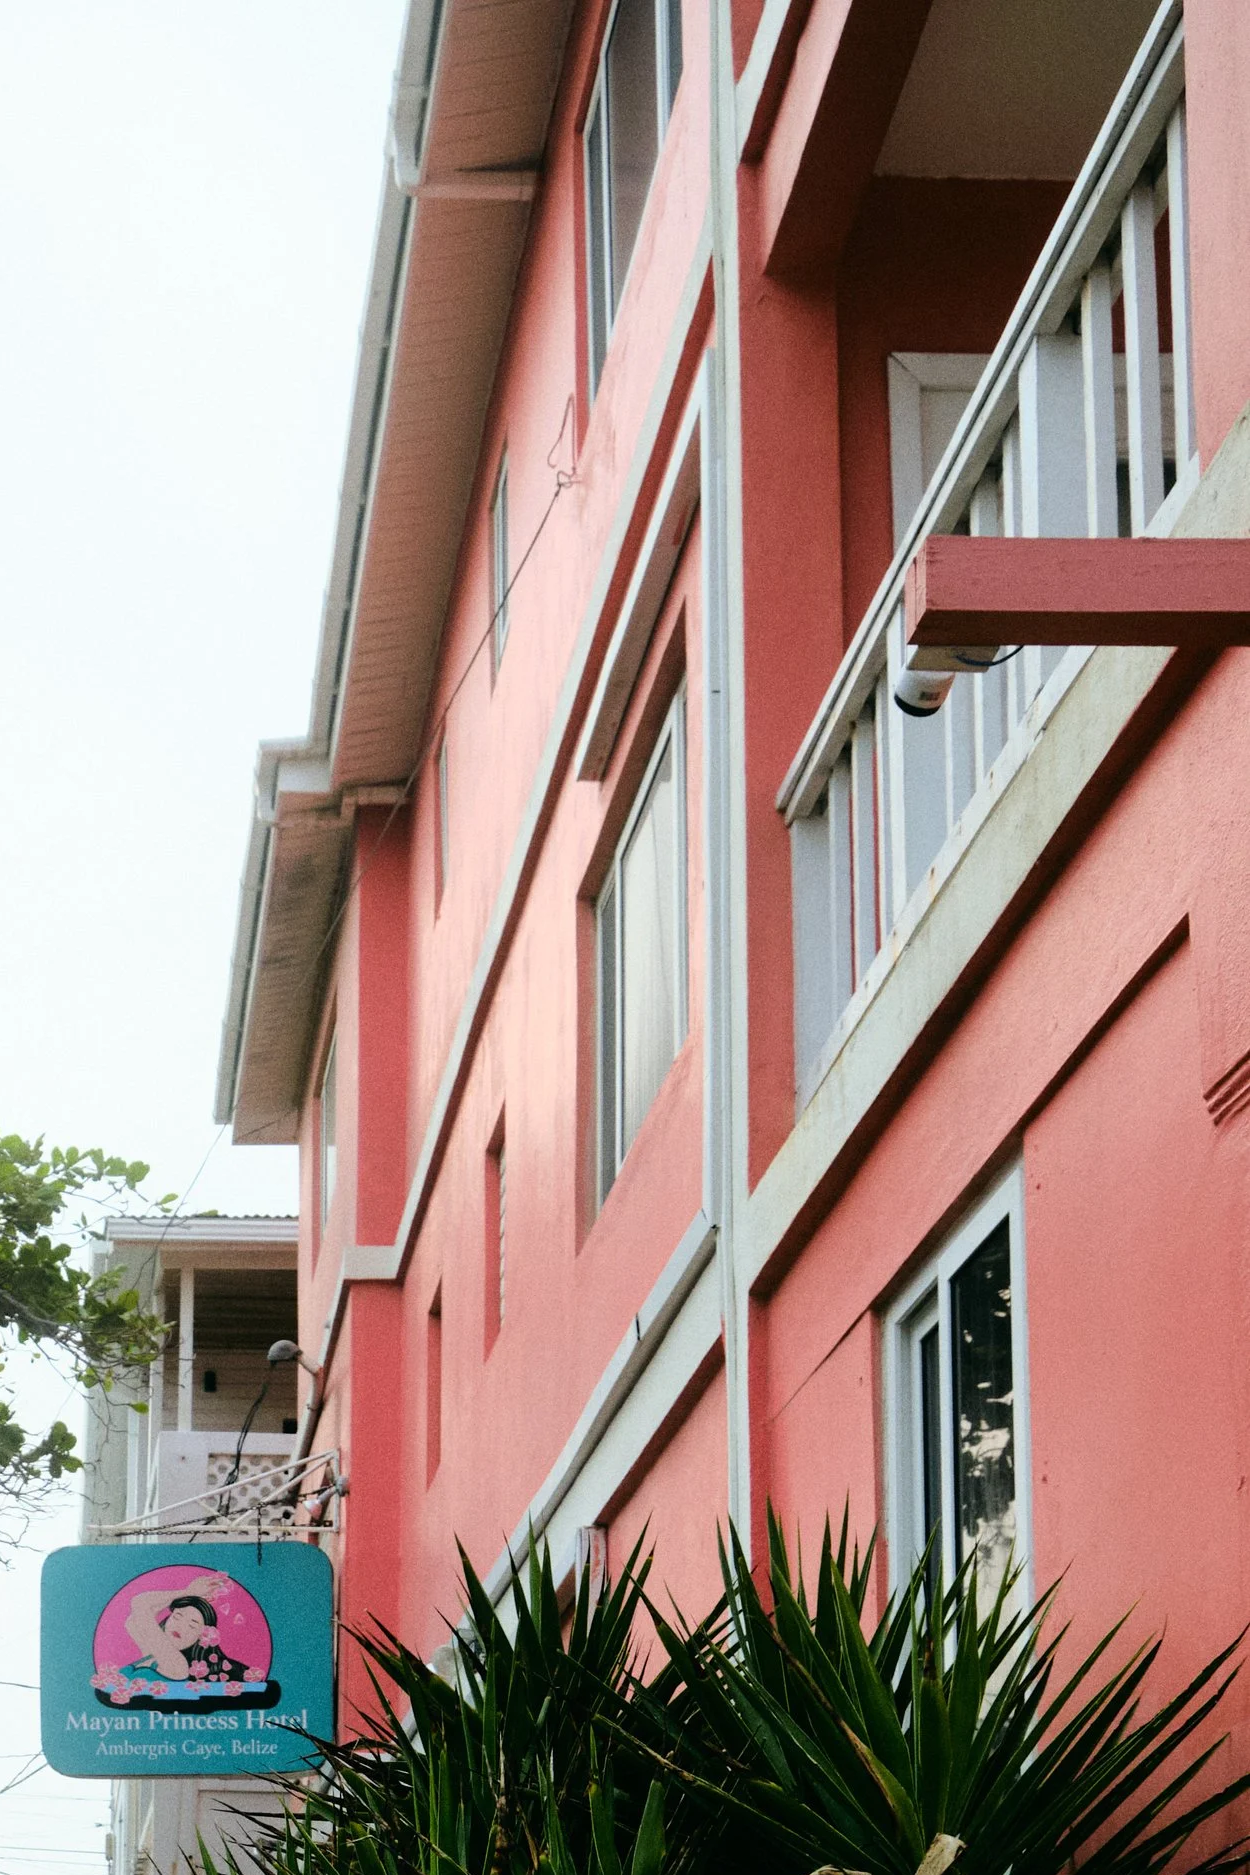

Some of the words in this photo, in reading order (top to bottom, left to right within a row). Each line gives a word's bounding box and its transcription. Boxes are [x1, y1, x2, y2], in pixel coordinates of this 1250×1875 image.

[66, 1711, 140, 1737] Mayan
[150, 1710, 238, 1730] Princess
[246, 1709, 308, 1730] Hotel
[96, 1740, 177, 1760] Ambergris
[182, 1740, 226, 1759] Caye,
[231, 1739, 278, 1755] Belize
